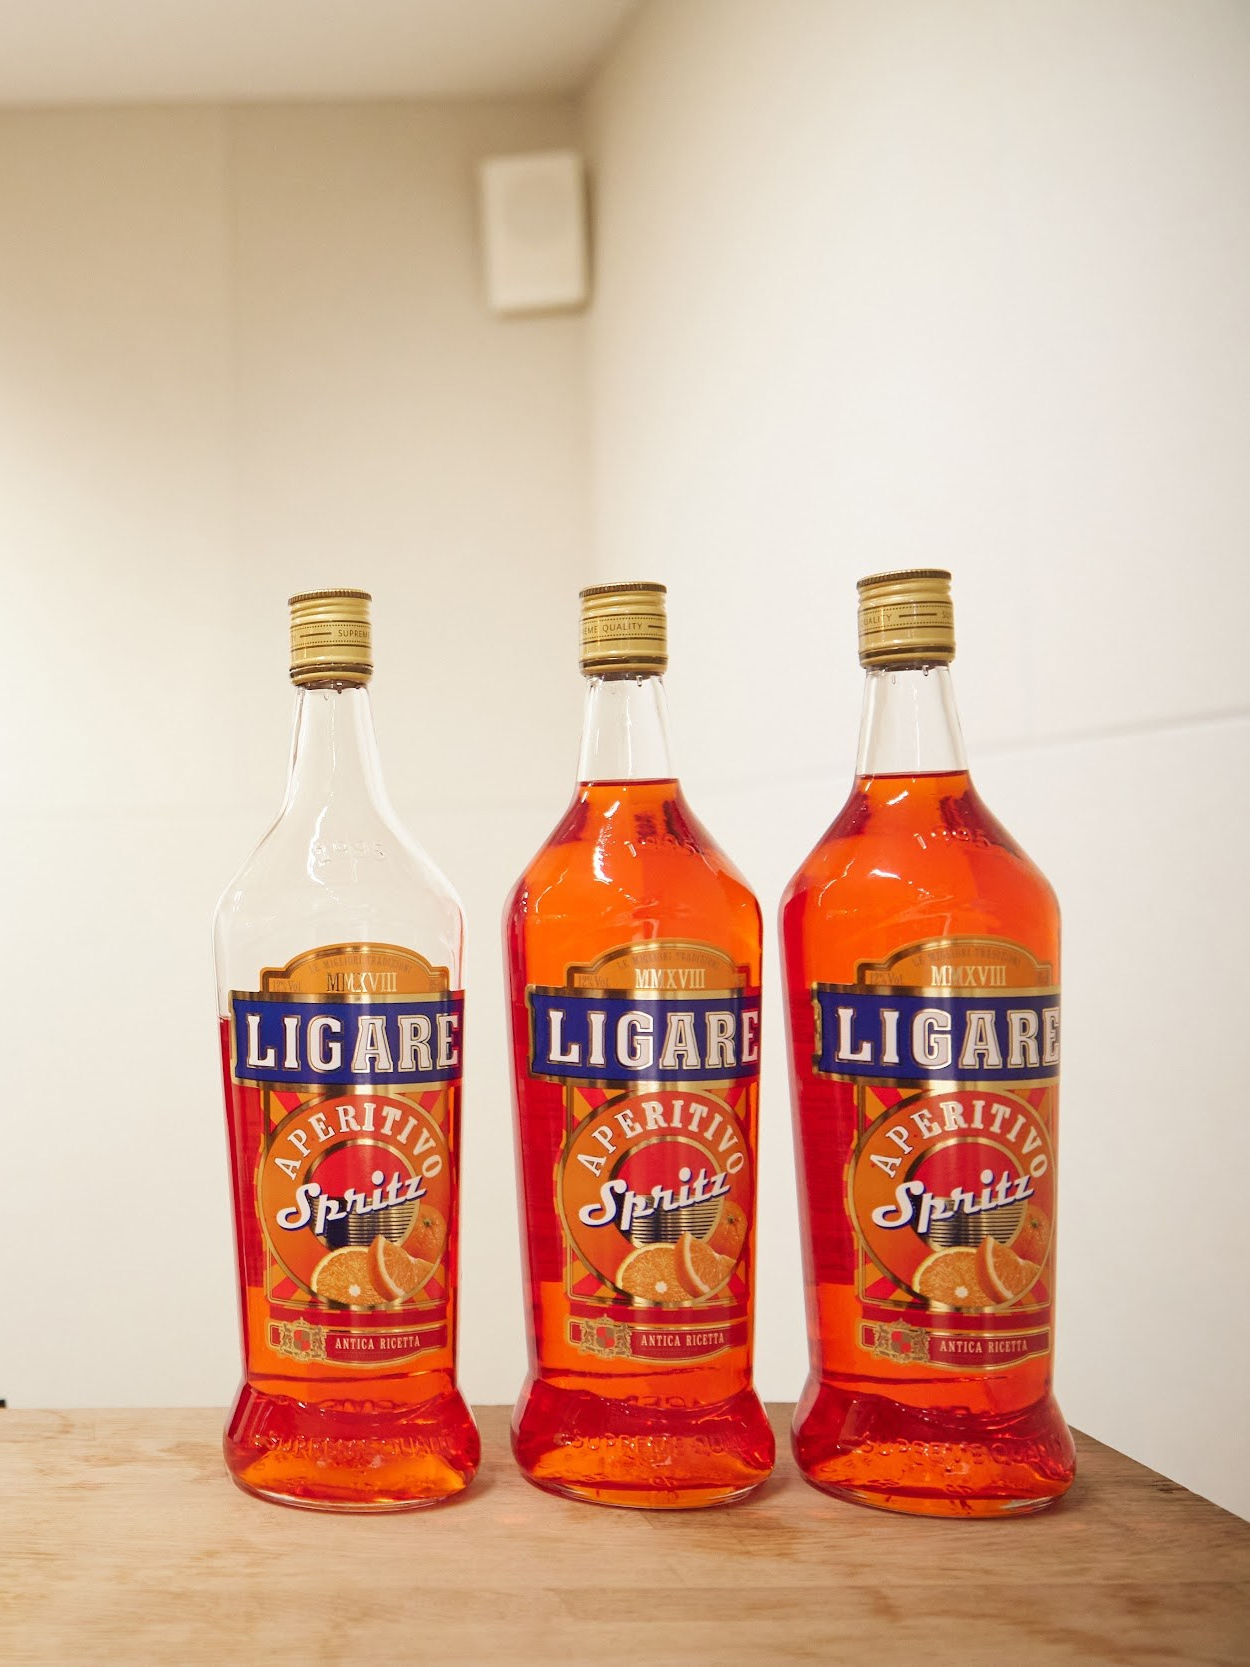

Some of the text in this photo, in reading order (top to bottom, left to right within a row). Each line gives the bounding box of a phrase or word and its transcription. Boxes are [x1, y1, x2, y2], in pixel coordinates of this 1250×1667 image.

[602, 622, 643, 633] QUALITY
[326, 971, 398, 993] MMXVIII
[635, 968, 706, 989] MMXVIII
[930, 965, 1007, 987] MMXVIII
[246, 1012, 460, 1074] LIGARE
[546, 1008, 759, 1071] LIGARE
[835, 1005, 1060, 1070] LIGARE
[273, 1102, 443, 1181] APERITIVO
[576, 1099, 745, 1178] APERITIVO
[869, 1099, 1048, 1179] APERITIVO
[275, 1170, 427, 1236] Spritz
[578, 1166, 732, 1232] Spritz
[871, 1168, 1035, 1234] Spritz
[335, 1335, 421, 1350] ANTICA RICETTA
[641, 1332, 725, 1347] ANTICA RICETTA
[939, 1339, 1028, 1354] ANTICA RICETTA
